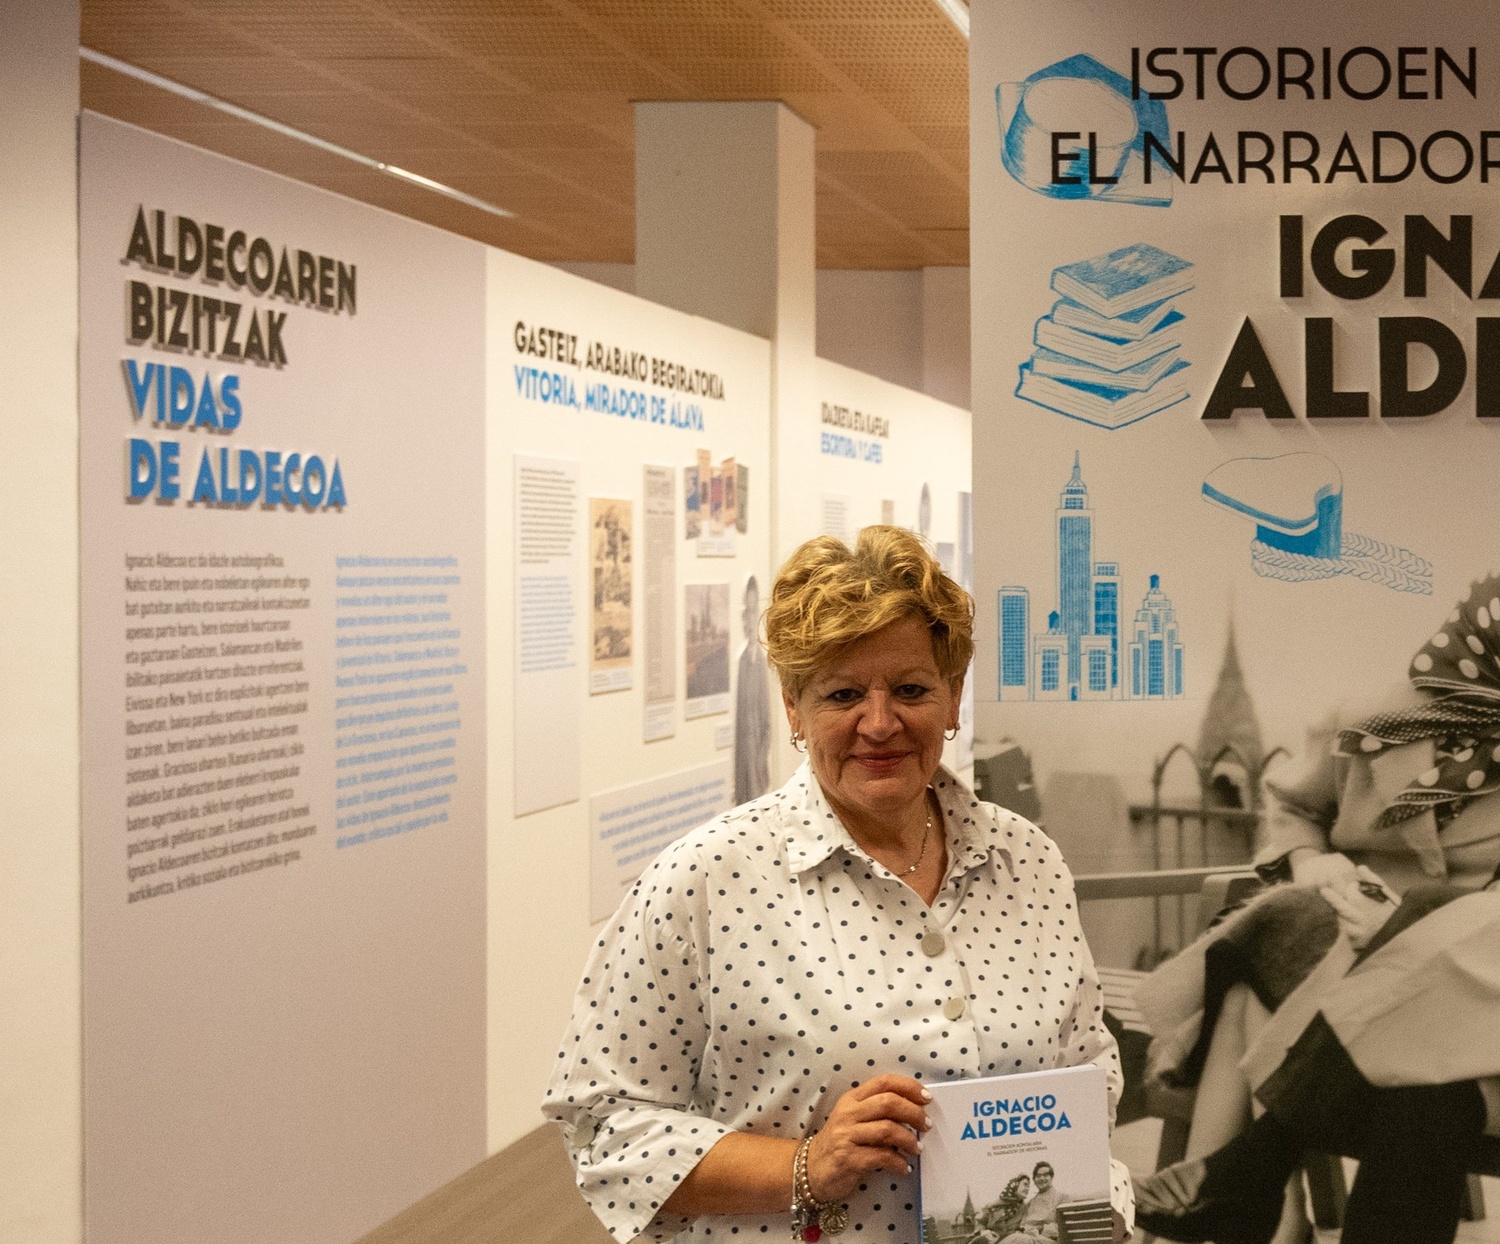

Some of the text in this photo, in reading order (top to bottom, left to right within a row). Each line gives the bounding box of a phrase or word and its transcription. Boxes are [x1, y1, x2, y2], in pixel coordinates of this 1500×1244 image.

[1130, 46, 1477, 101] ISTORIOEN
[1050, 130, 1119, 185] EL
[125, 204, 358, 314] ALDECOAREN
[129, 280, 288, 365] BIZITZAK
[125, 358, 243, 430] VIDAS
[514, 320, 726, 402] GASTEIZ, ARABAKO BEGIRATOKIA
[513, 364, 581, 412] VITORIA,
[584, 382, 648, 421] MIRADOR
[650, 395, 667, 425] DE
[129, 437, 348, 509] DE ALDECOA
[960, 1112, 1072, 1141] ALDECOA
[972, 1094, 1057, 1118] IGNACIO
